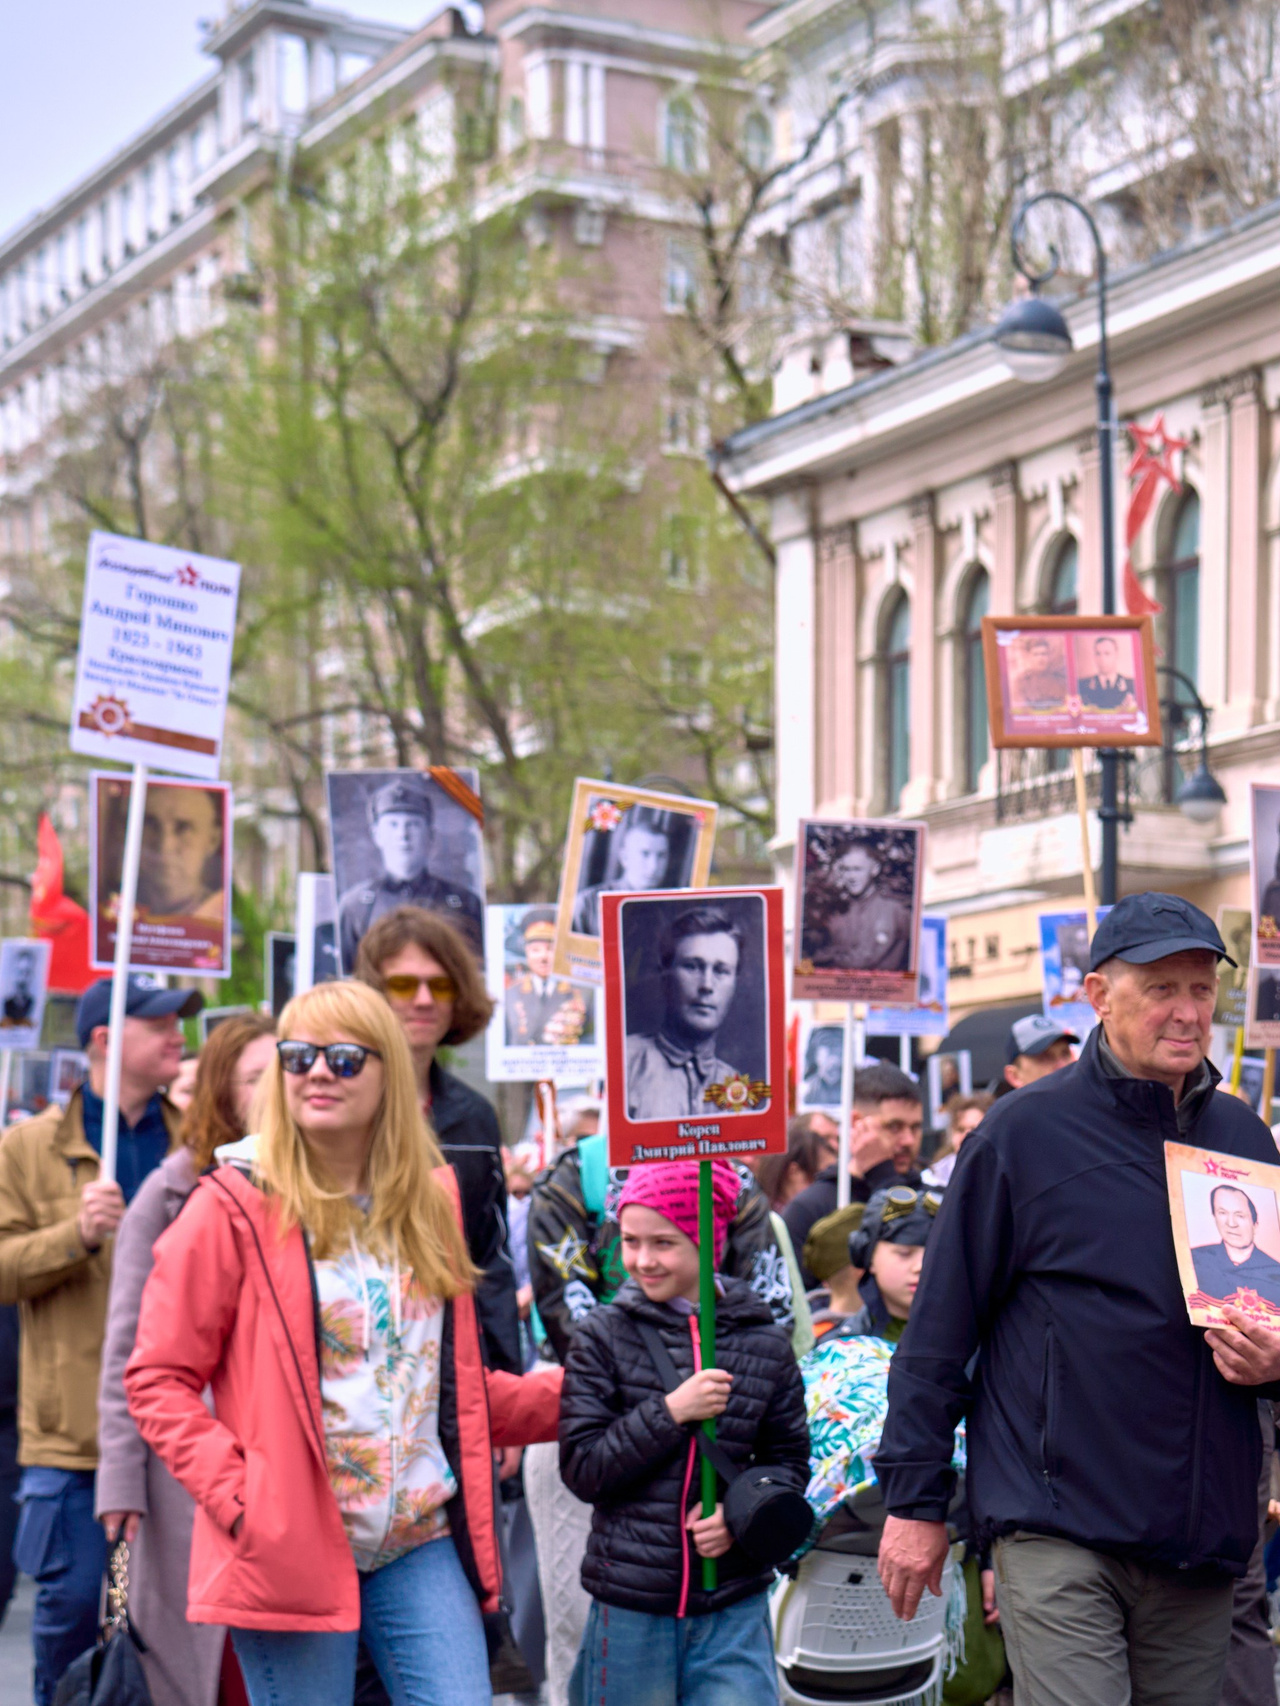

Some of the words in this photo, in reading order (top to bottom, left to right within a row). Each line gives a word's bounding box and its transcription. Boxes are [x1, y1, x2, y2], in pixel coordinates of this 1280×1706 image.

[91, 601, 150, 624] Андрей
[631, 1142, 695, 1162] Дмитрий
[699, 1137, 766, 1154] Павлович
